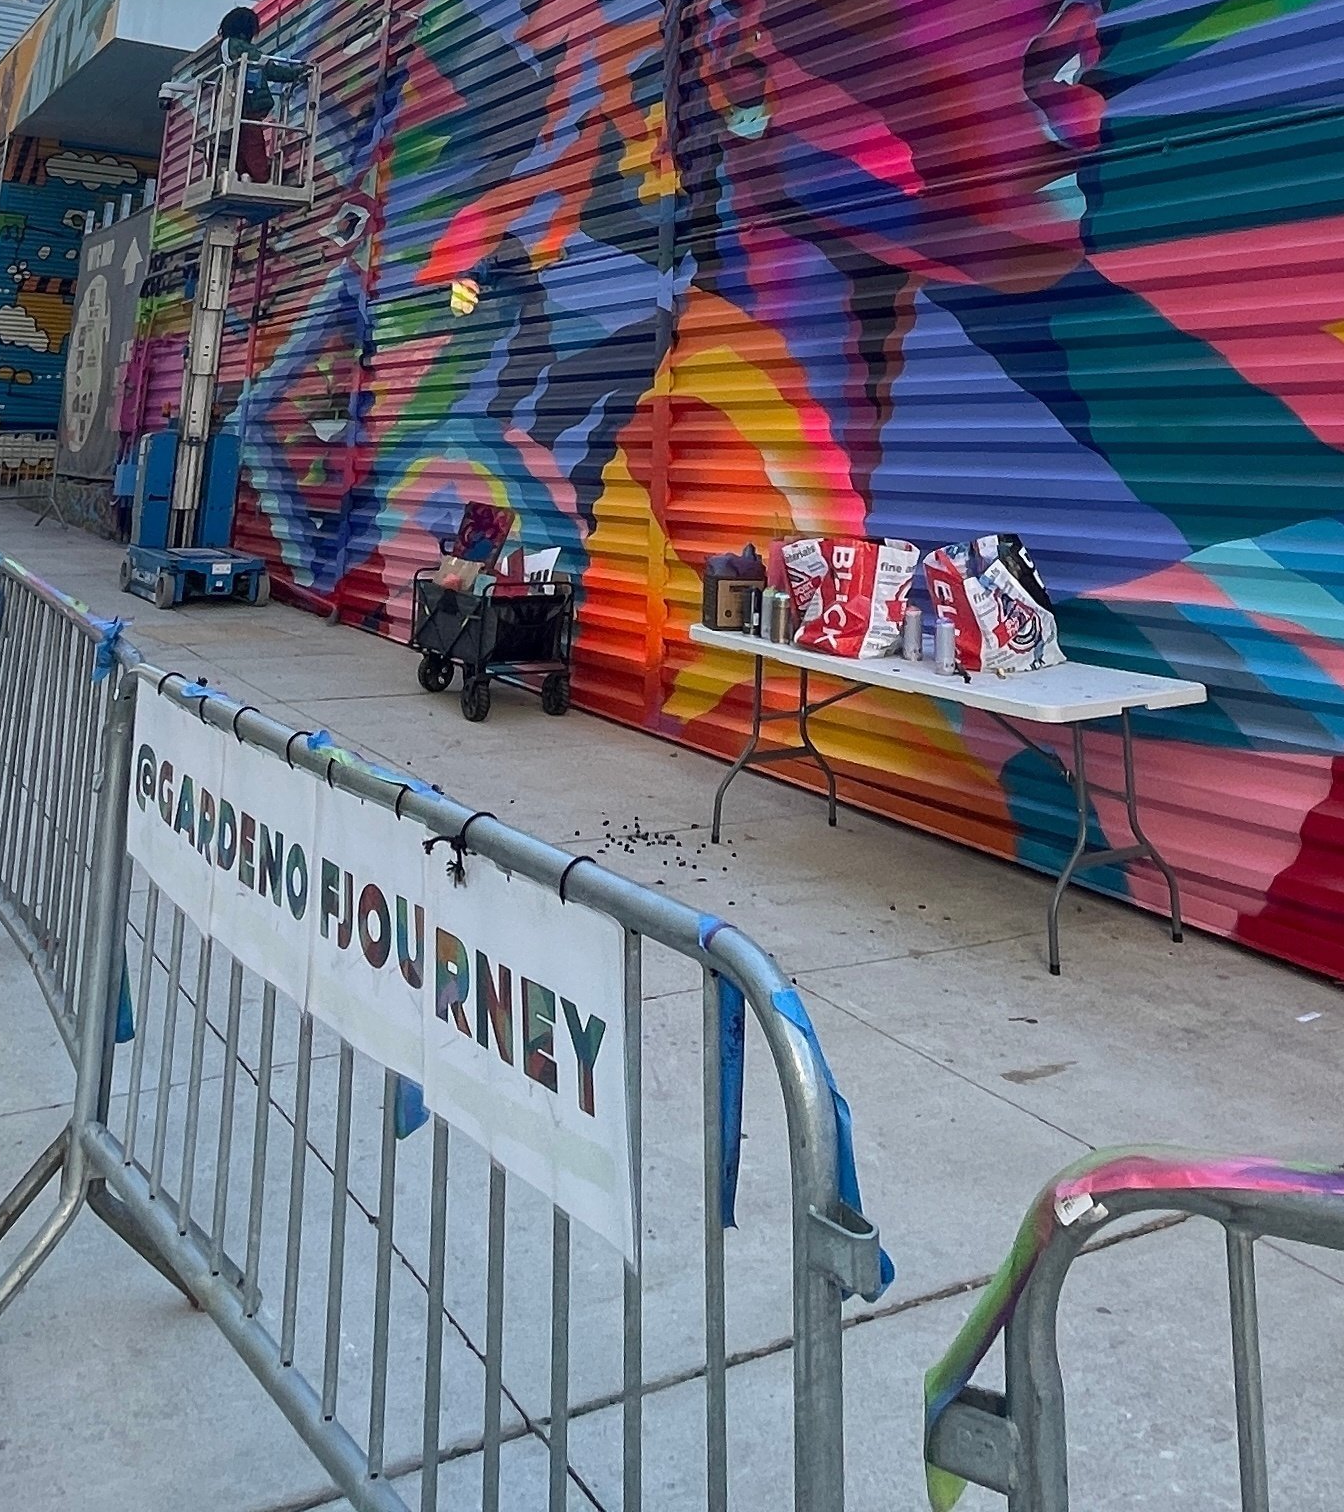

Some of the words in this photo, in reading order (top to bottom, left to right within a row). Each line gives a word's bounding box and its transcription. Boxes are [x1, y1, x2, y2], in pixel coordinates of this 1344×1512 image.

[813, 545, 856, 649] BLICK
[880, 561, 902, 573] fine
[136, 743, 308, 921] @GARDENO
[320, 857, 607, 1118] FJOURNEY
